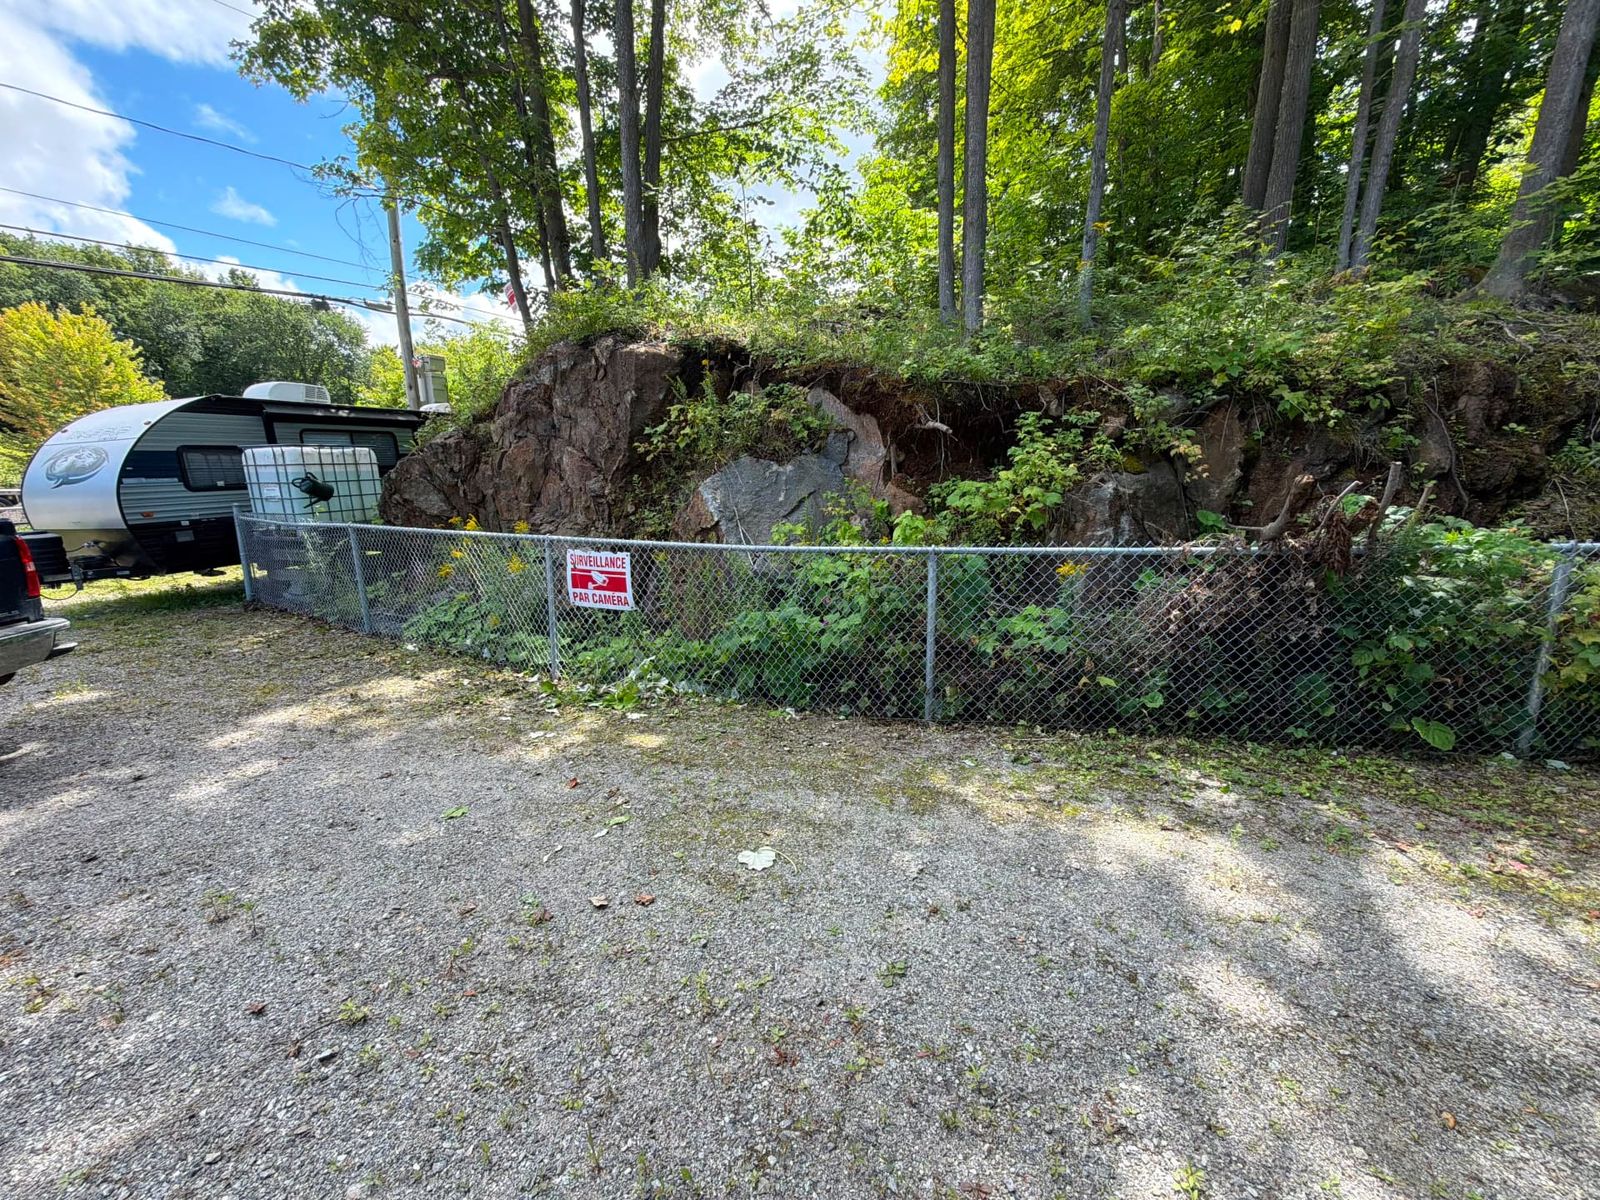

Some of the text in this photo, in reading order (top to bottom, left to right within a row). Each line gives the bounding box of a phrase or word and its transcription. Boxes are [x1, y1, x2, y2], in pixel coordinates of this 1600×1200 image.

[570, 554, 626, 569] SURVEILLANCE
[573, 592, 630, 607] PAR CAMÉRA
